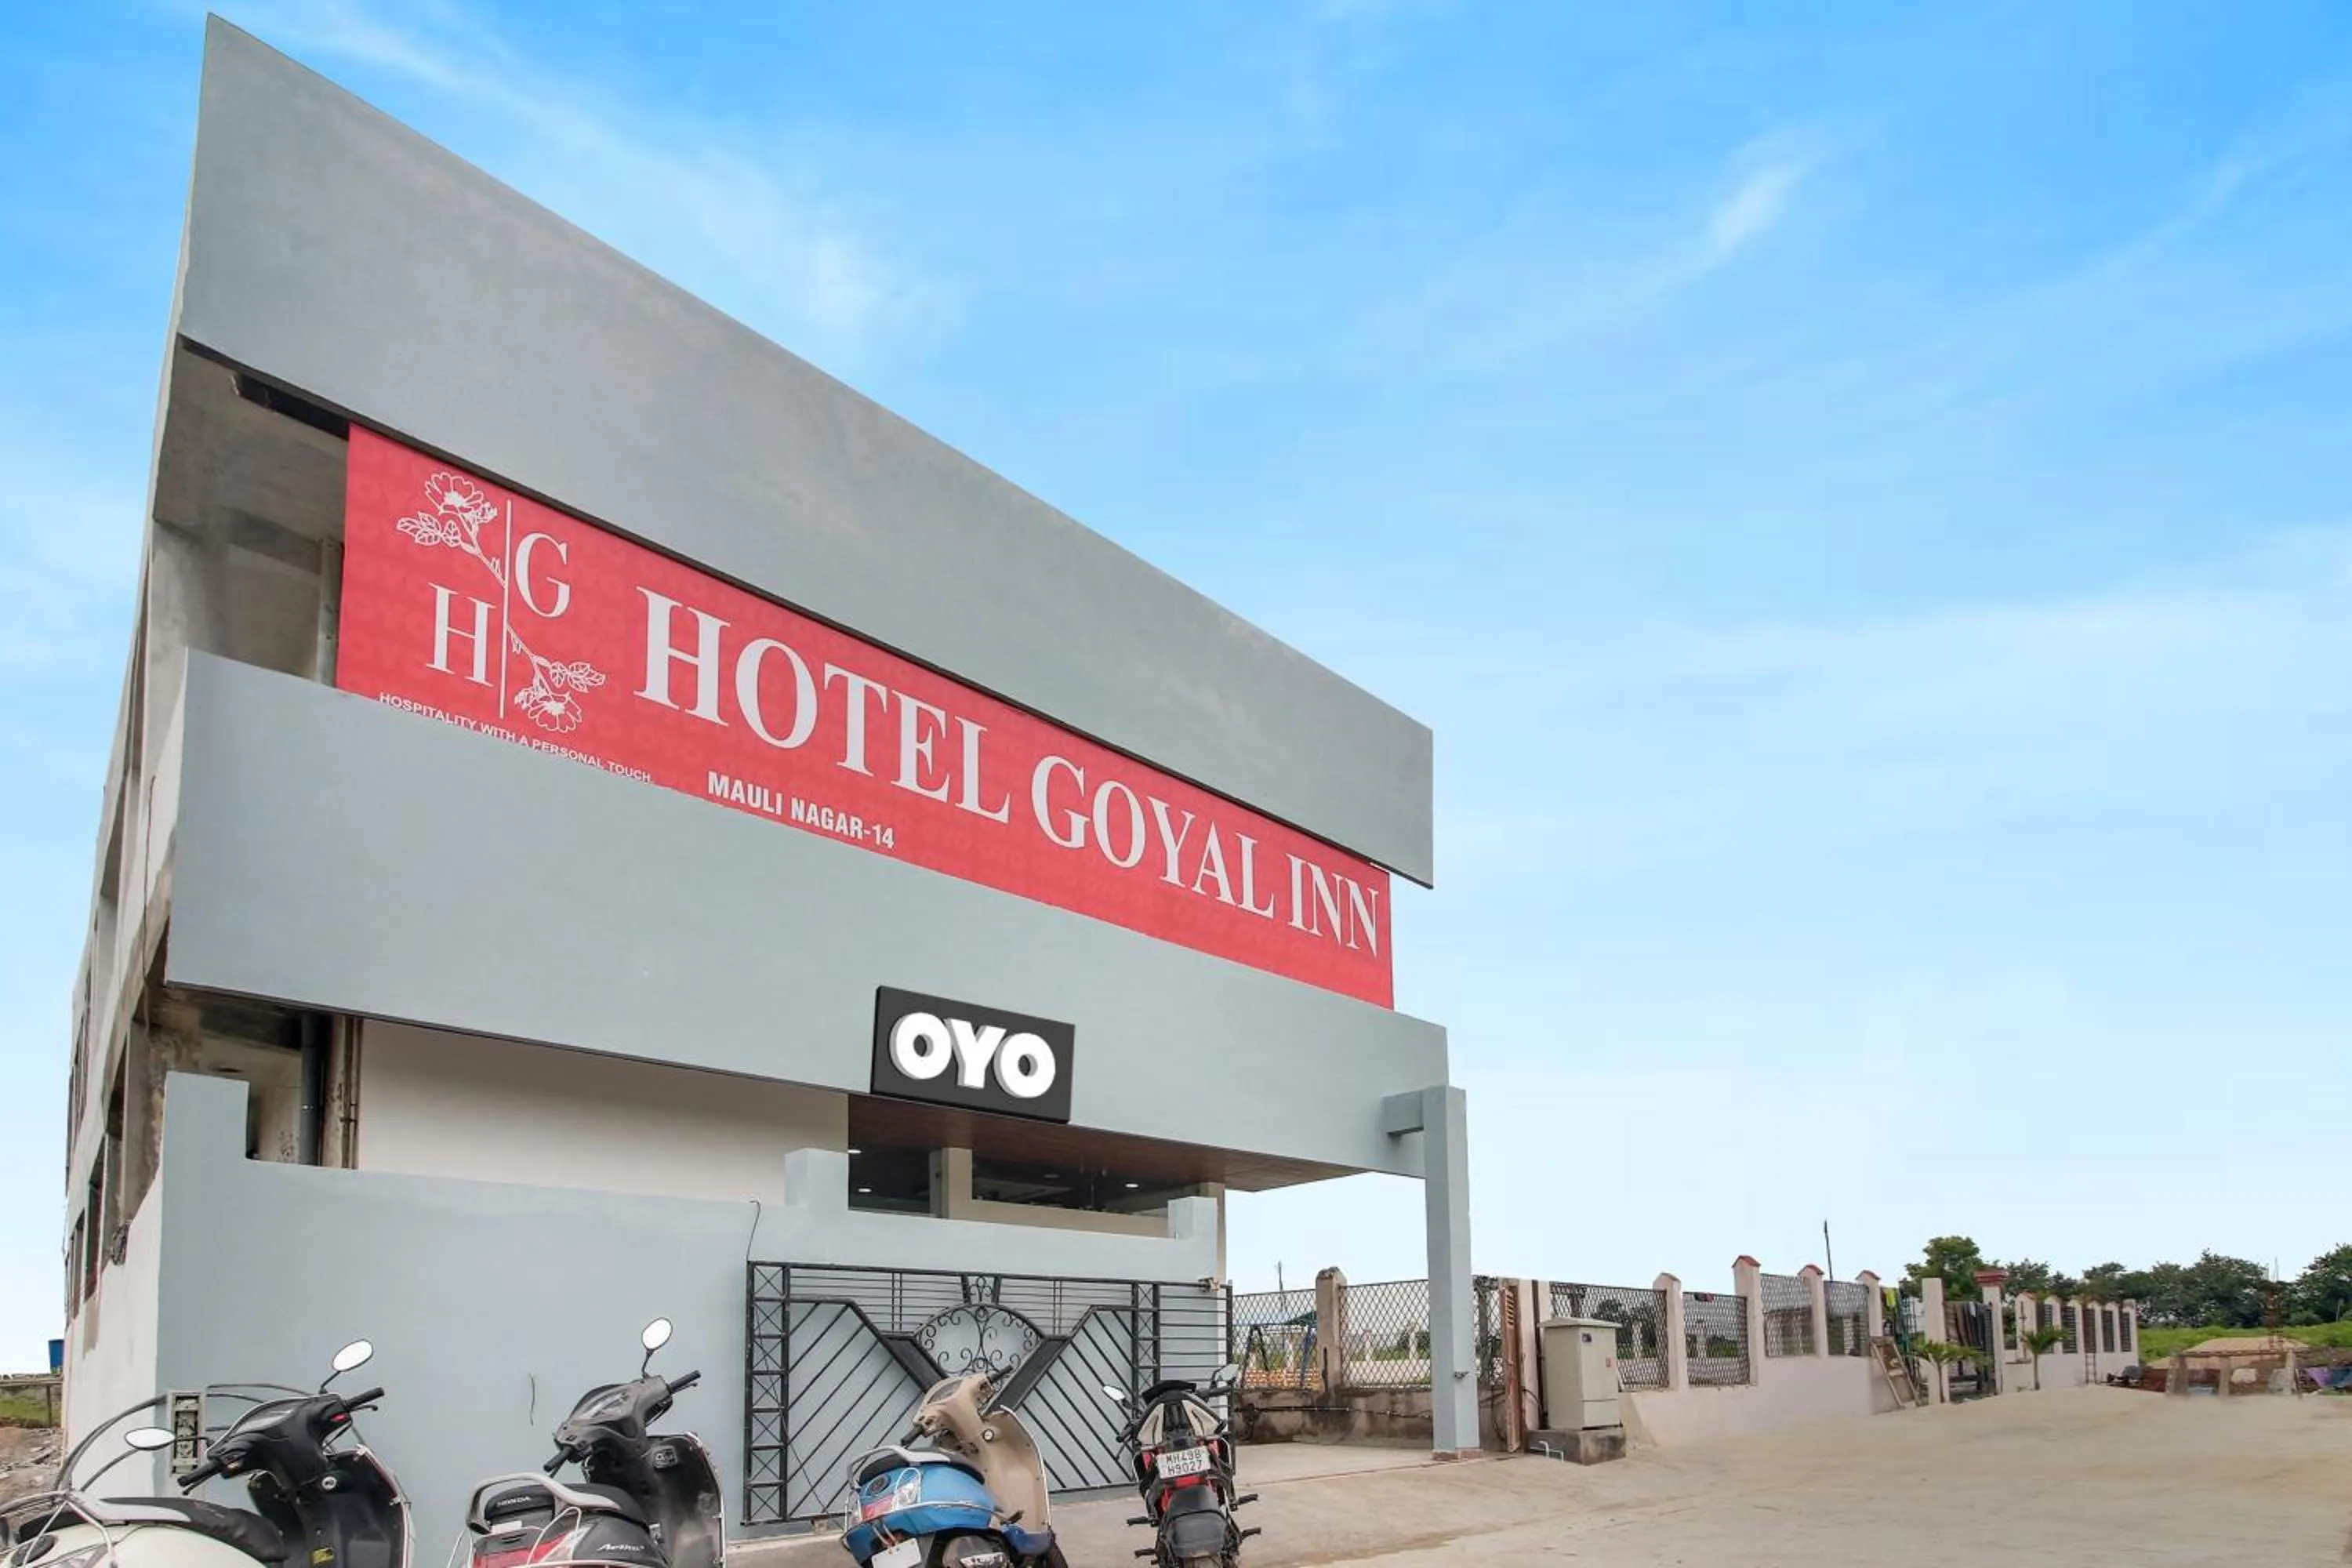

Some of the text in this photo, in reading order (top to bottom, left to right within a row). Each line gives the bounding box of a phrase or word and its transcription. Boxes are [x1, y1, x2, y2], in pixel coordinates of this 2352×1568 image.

[514, 532, 571, 619] G
[426, 582, 496, 688] H
[379, 691, 652, 783] HOSPITALITY WITH A PERSONAL TOUCH
[633, 586, 1379, 958] HOTEL GOYAL INN
[708, 770, 895, 850] MAULI NAGAR-14
[889, 1012, 1056, 1098] OYO
